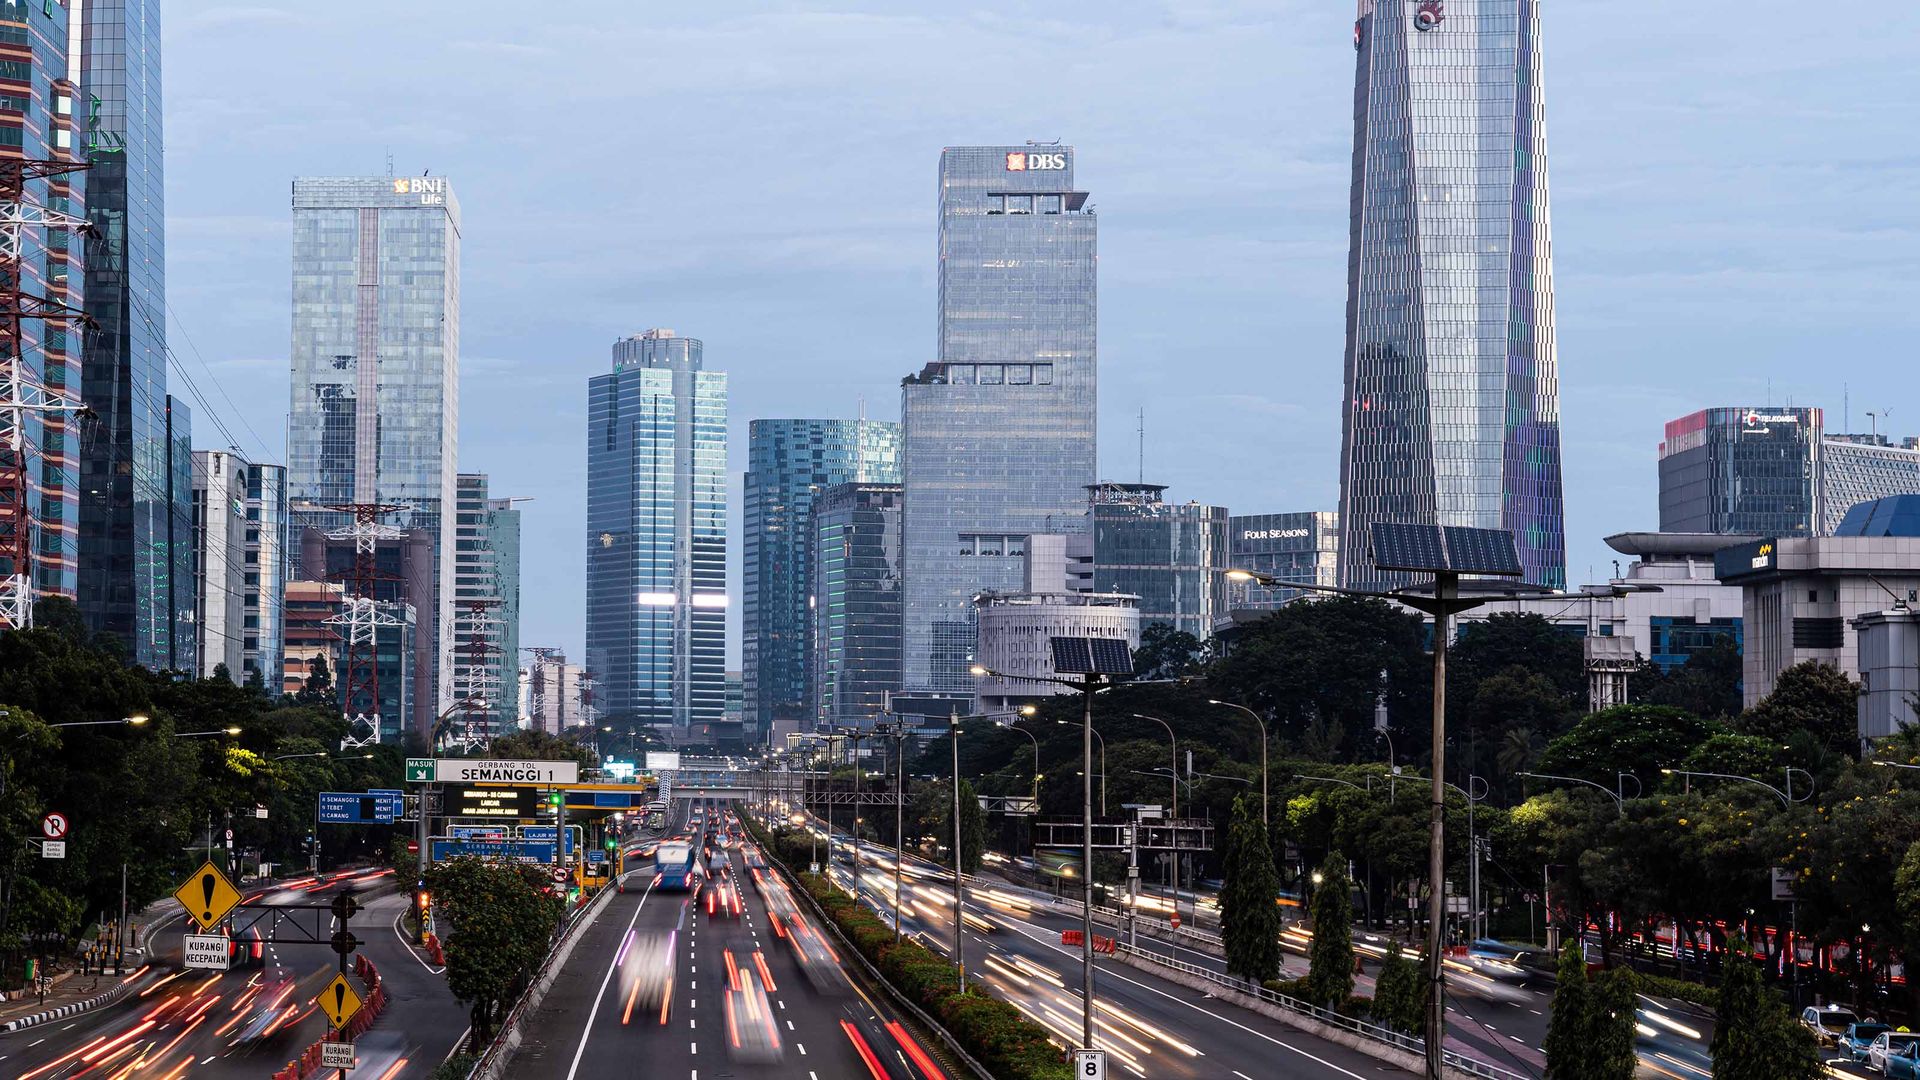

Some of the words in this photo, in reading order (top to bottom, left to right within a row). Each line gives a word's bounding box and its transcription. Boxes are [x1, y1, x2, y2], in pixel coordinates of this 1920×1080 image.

[1028, 154, 1065, 170] DBS
[411, 179, 441, 193] BNI
[421, 194, 442, 204] Life
[1244, 530, 1267, 539] FOUR
[1269, 528, 1308, 538] SEASONS
[461, 769, 540, 781] SEMANGGI
[549, 770, 553, 781] 1
[190, 942, 224, 952] KURANGI
[186, 954, 226, 964] KECEPATAN
[325, 1046, 351, 1055] KURANGI
[323, 1056, 353, 1065] KECEPATAN
[1085, 1062, 1097, 1076] 8
